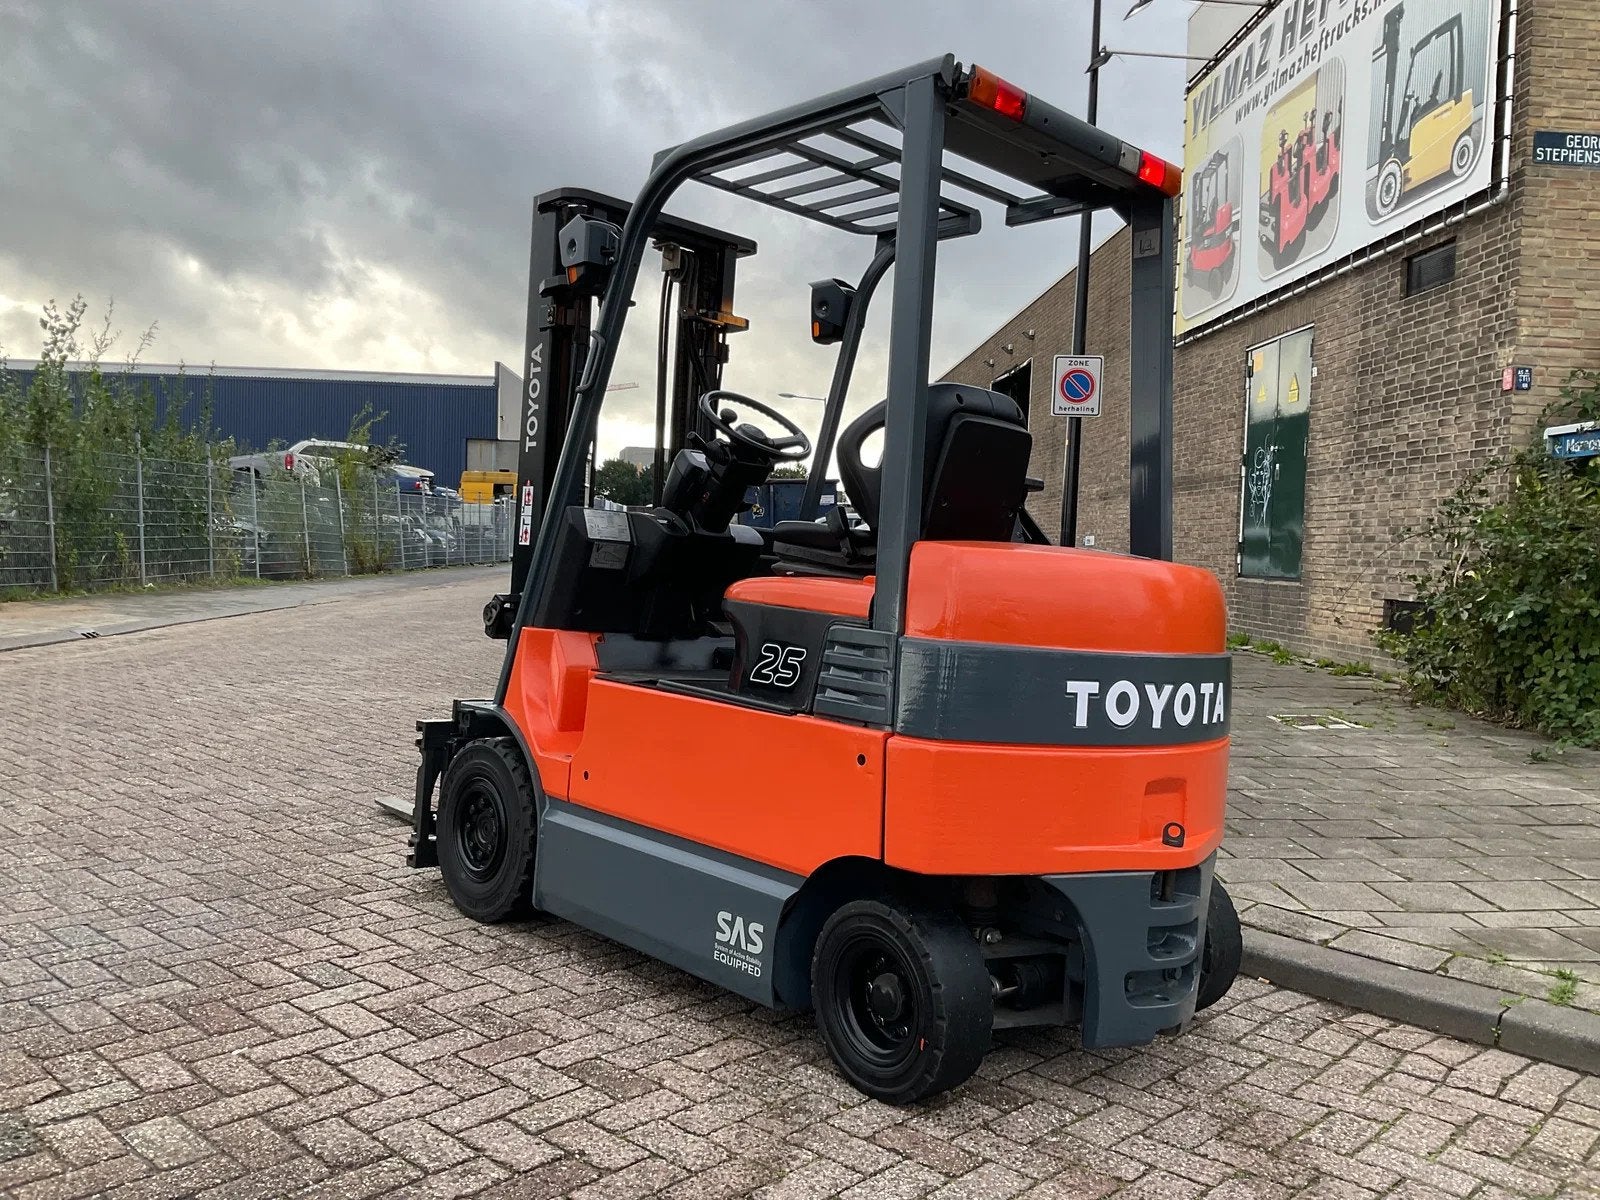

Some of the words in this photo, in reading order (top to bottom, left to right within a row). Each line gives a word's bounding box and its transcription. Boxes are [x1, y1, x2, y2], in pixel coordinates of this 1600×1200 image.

[1192, 22, 1276, 139] YILMAZ
[1566, 134, 1600, 149] GEOR
[525, 342, 543, 453] TOYOTA
[1058, 405, 1095, 413] herhaling
[749, 643, 807, 687] 25
[1066, 680, 1224, 729] TOYOTA
[715, 910, 764, 954] SAS
[713, 950, 761, 978] EQUIPPED
